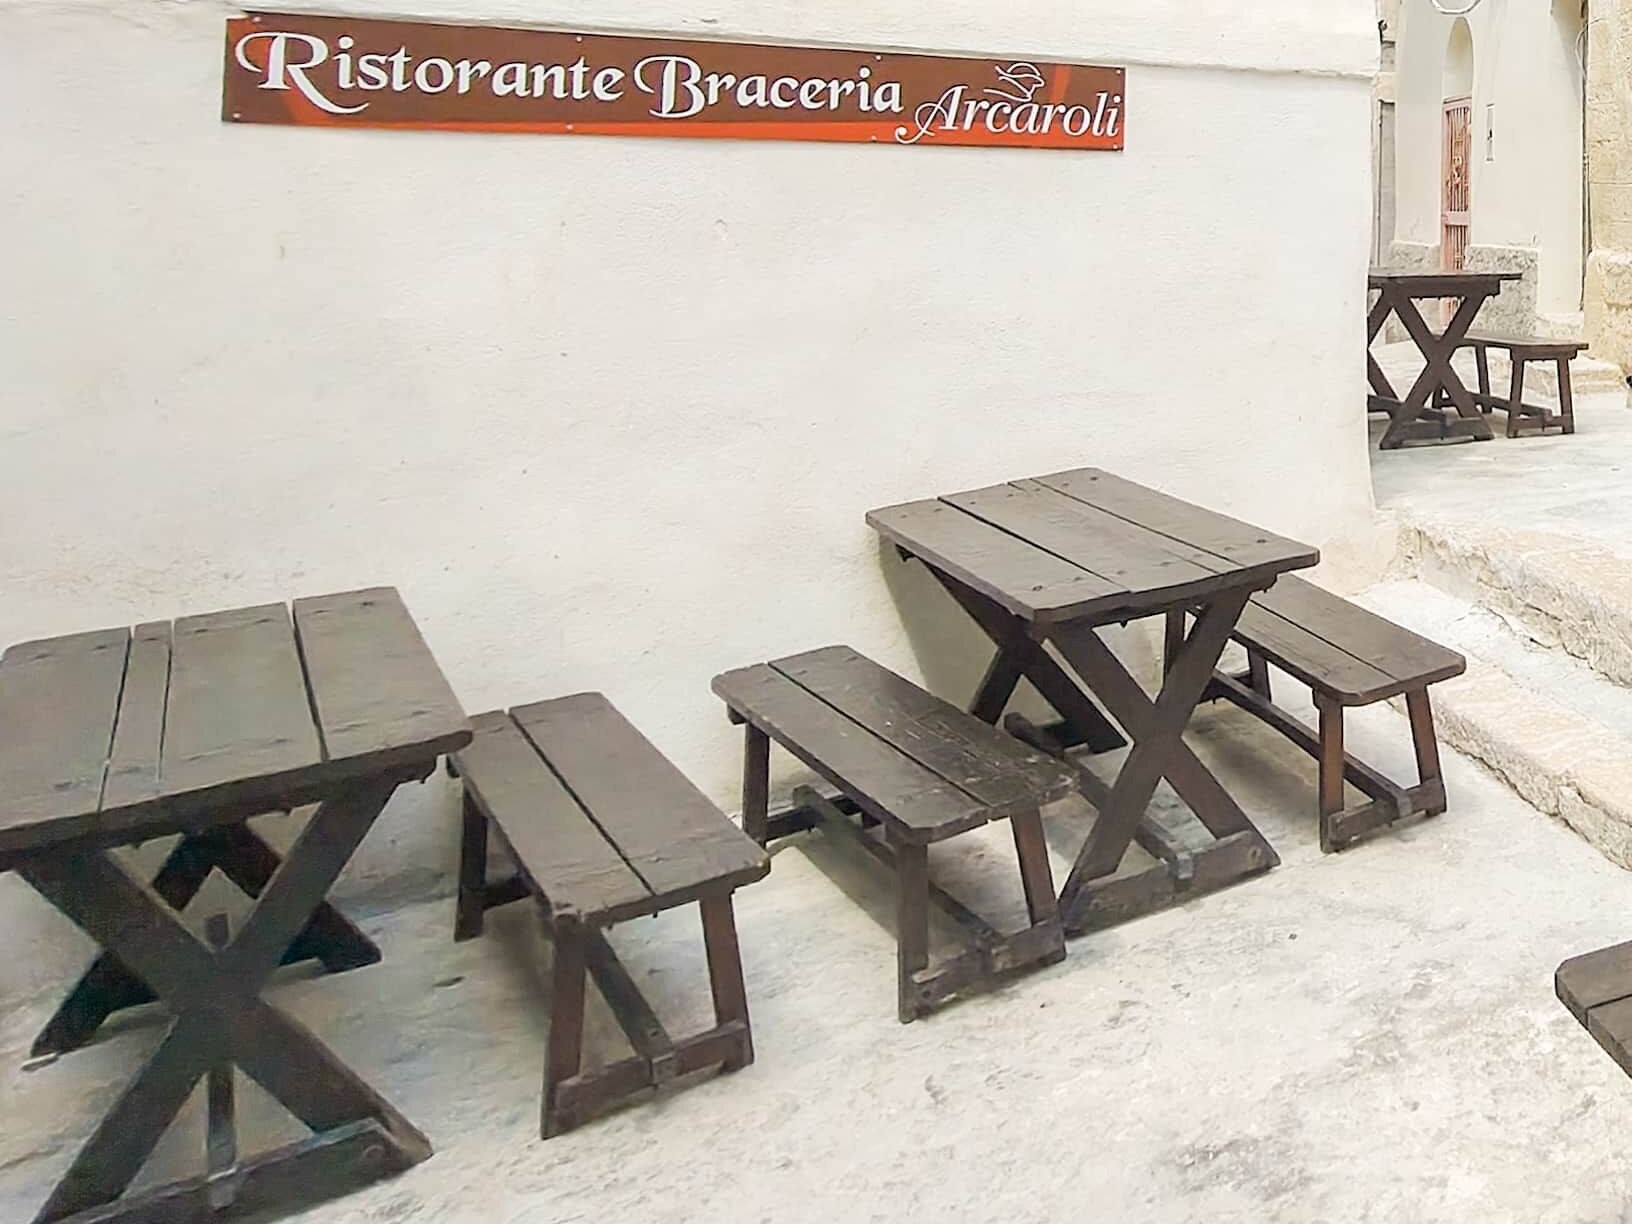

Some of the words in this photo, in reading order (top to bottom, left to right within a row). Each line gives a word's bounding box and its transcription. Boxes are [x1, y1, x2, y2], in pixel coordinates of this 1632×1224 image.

[234, 31, 625, 115] Ristorante
[634, 55, 903, 119] Braceria
[895, 85, 1122, 144] Arcaroli
